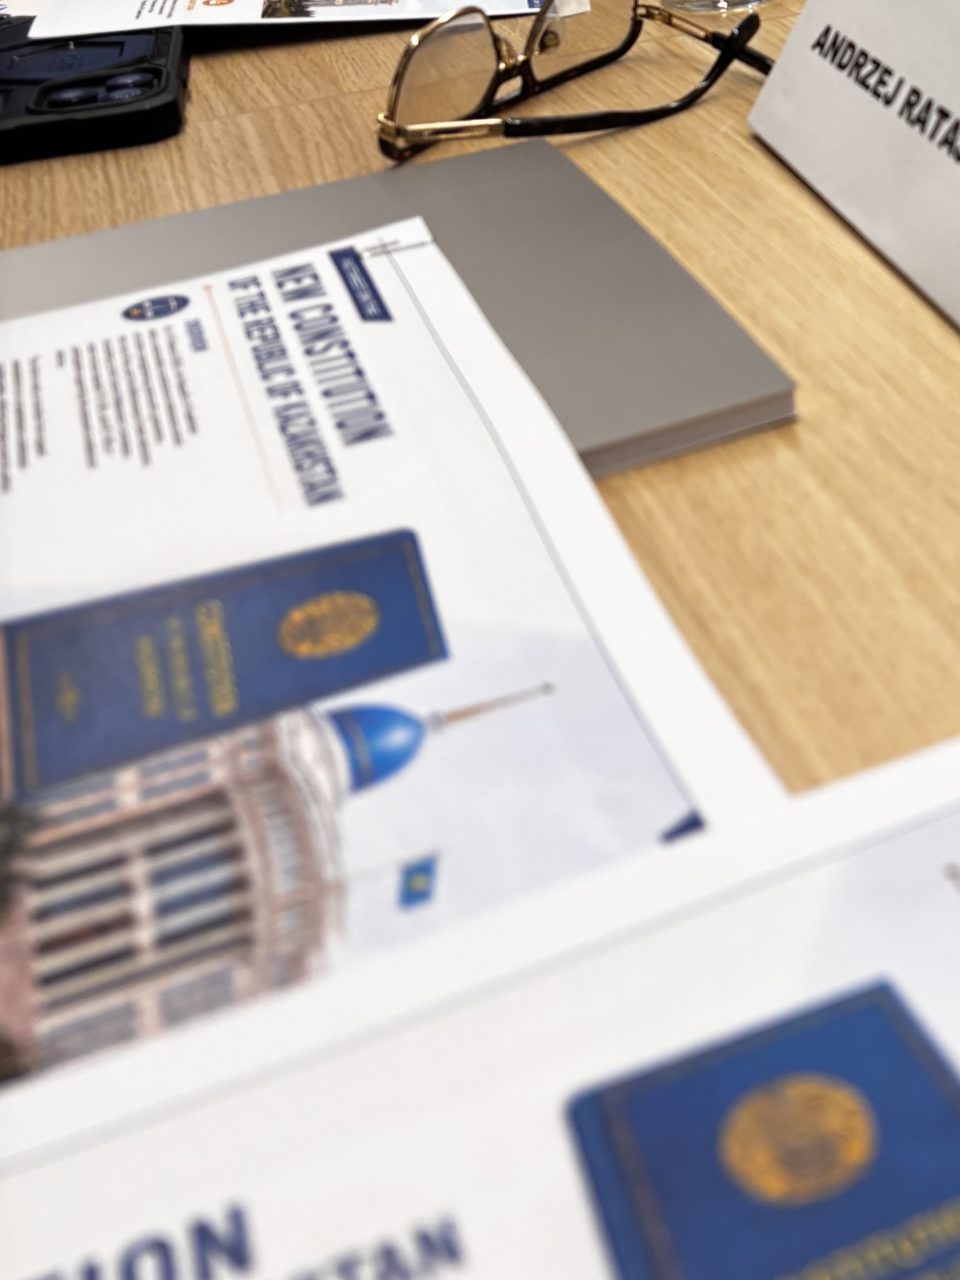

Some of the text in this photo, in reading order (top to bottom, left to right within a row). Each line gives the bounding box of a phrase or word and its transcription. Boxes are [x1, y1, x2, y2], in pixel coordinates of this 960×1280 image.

[811, 23, 906, 109] ANDRZEJ
[272, 262, 328, 303] NEW
[288, 302, 395, 447] CONSTITUTION
